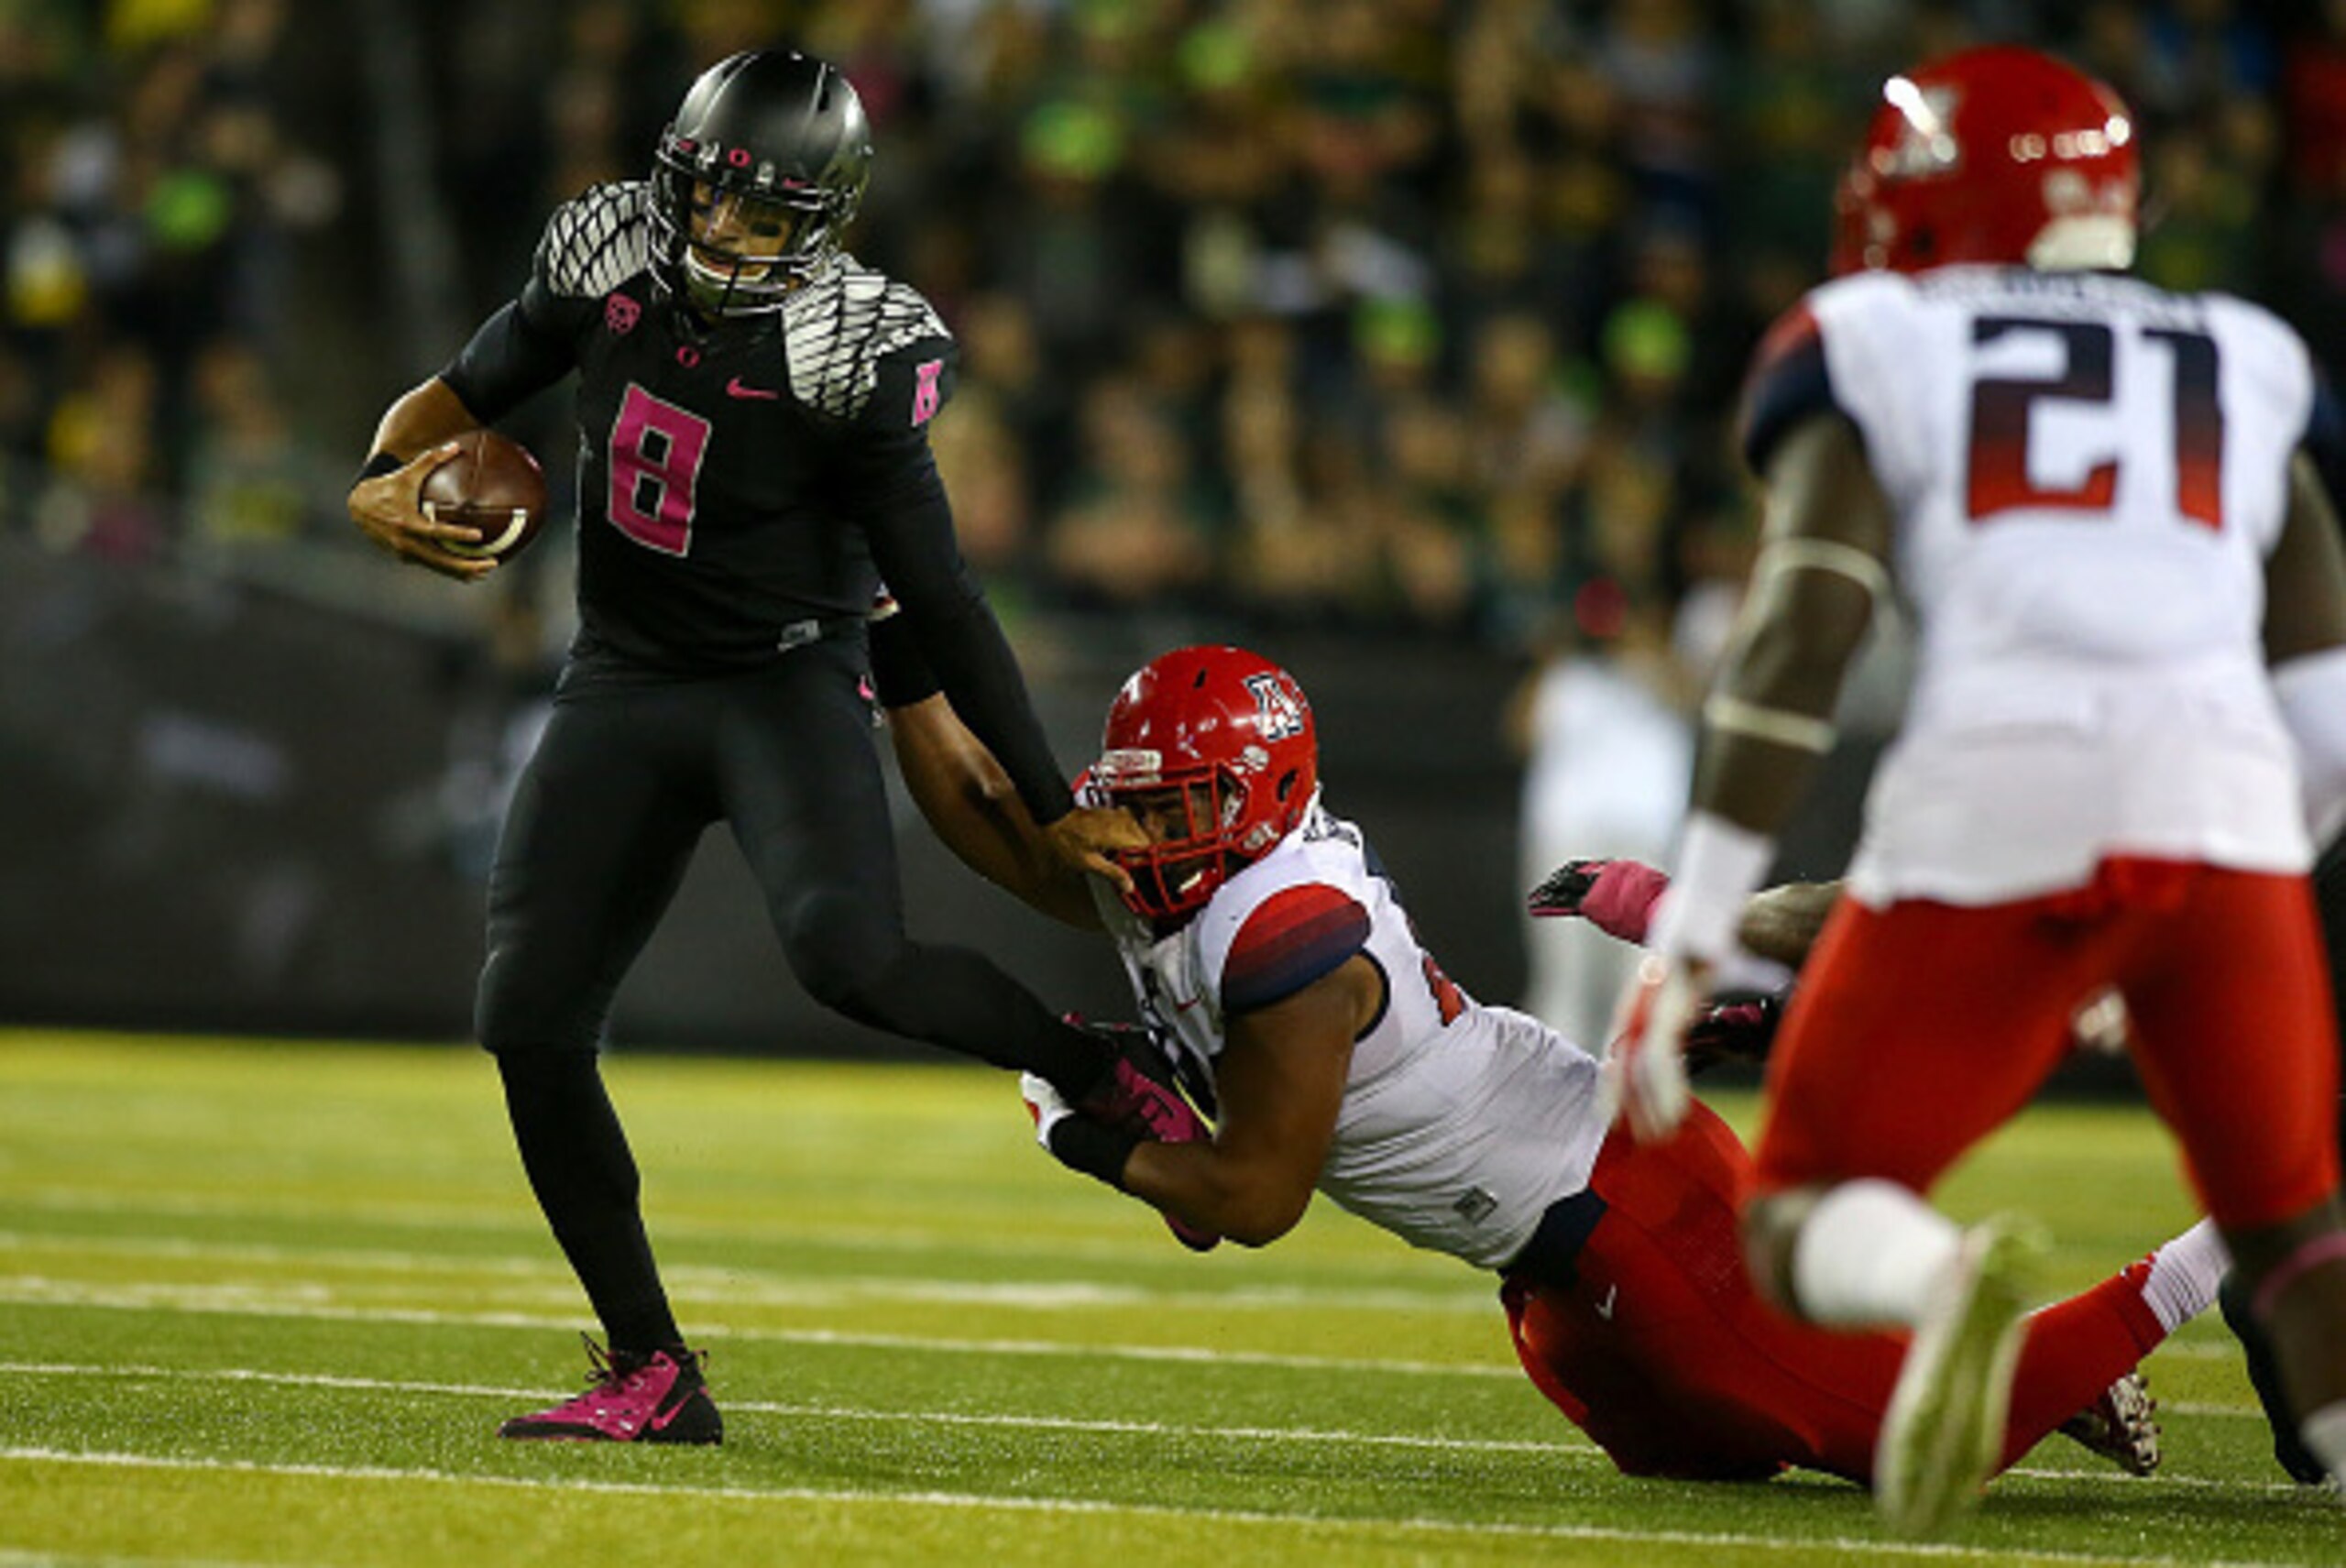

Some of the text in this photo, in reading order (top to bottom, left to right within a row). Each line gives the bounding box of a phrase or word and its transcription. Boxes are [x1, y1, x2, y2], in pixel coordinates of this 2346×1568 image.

[608, 381, 712, 558] 8
[1967, 314, 2223, 532] 21
[1243, 671, 1304, 741] A
